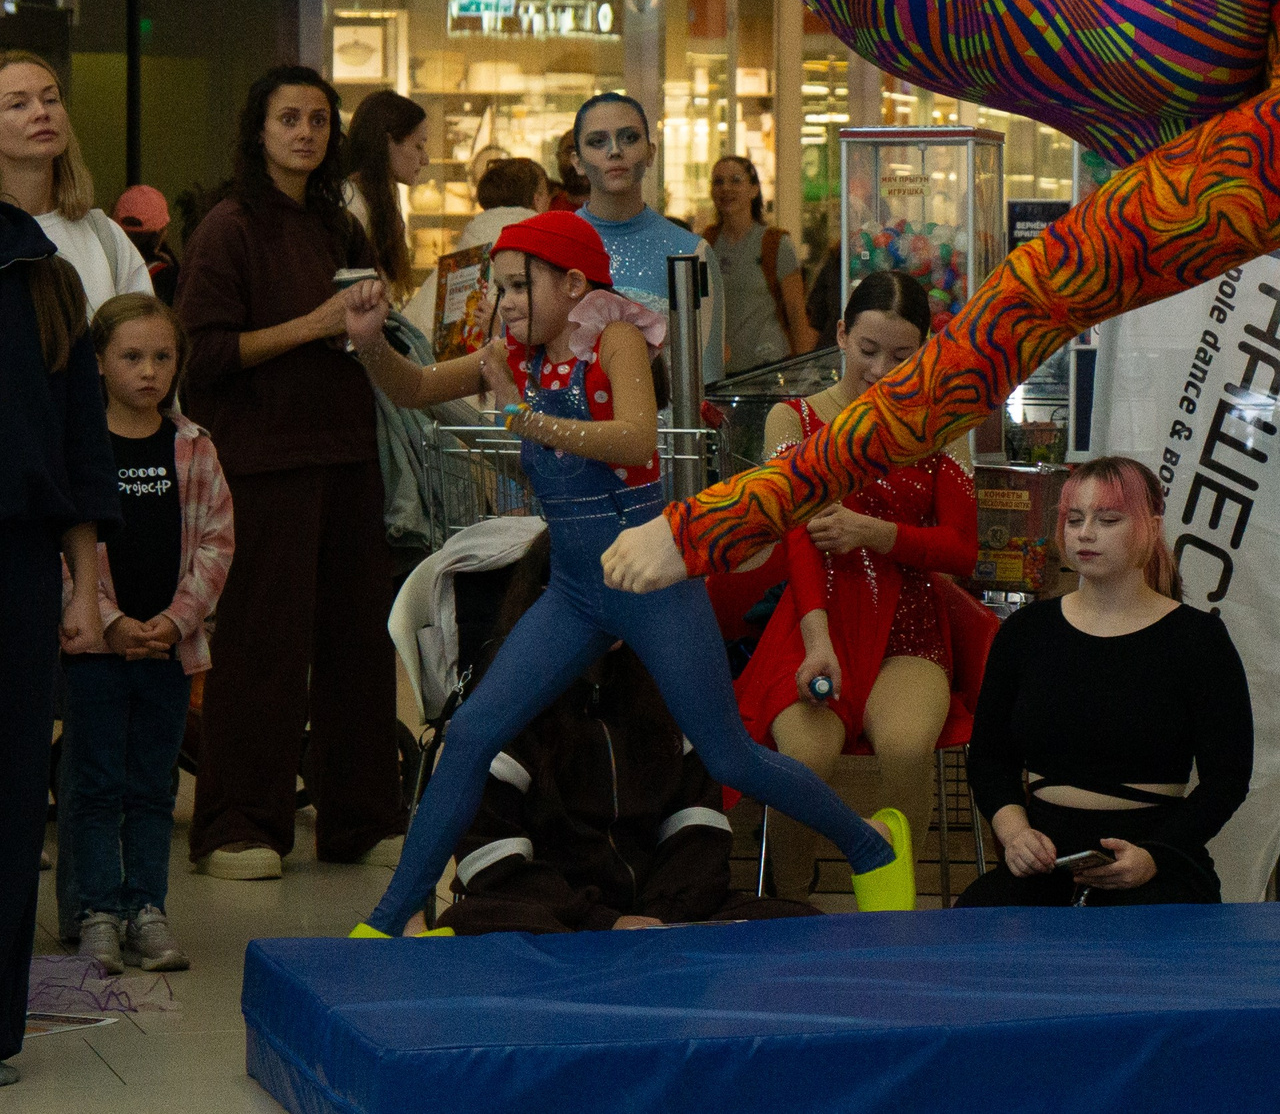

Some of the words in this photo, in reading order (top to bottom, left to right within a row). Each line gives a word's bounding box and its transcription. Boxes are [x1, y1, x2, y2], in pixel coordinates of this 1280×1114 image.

[887, 188, 925, 196] ИГРУШКА
[1178, 329, 1222, 415] dance
[1170, 419, 1193, 441] &
[984, 490, 1023, 498] КОНФЕТЫ
